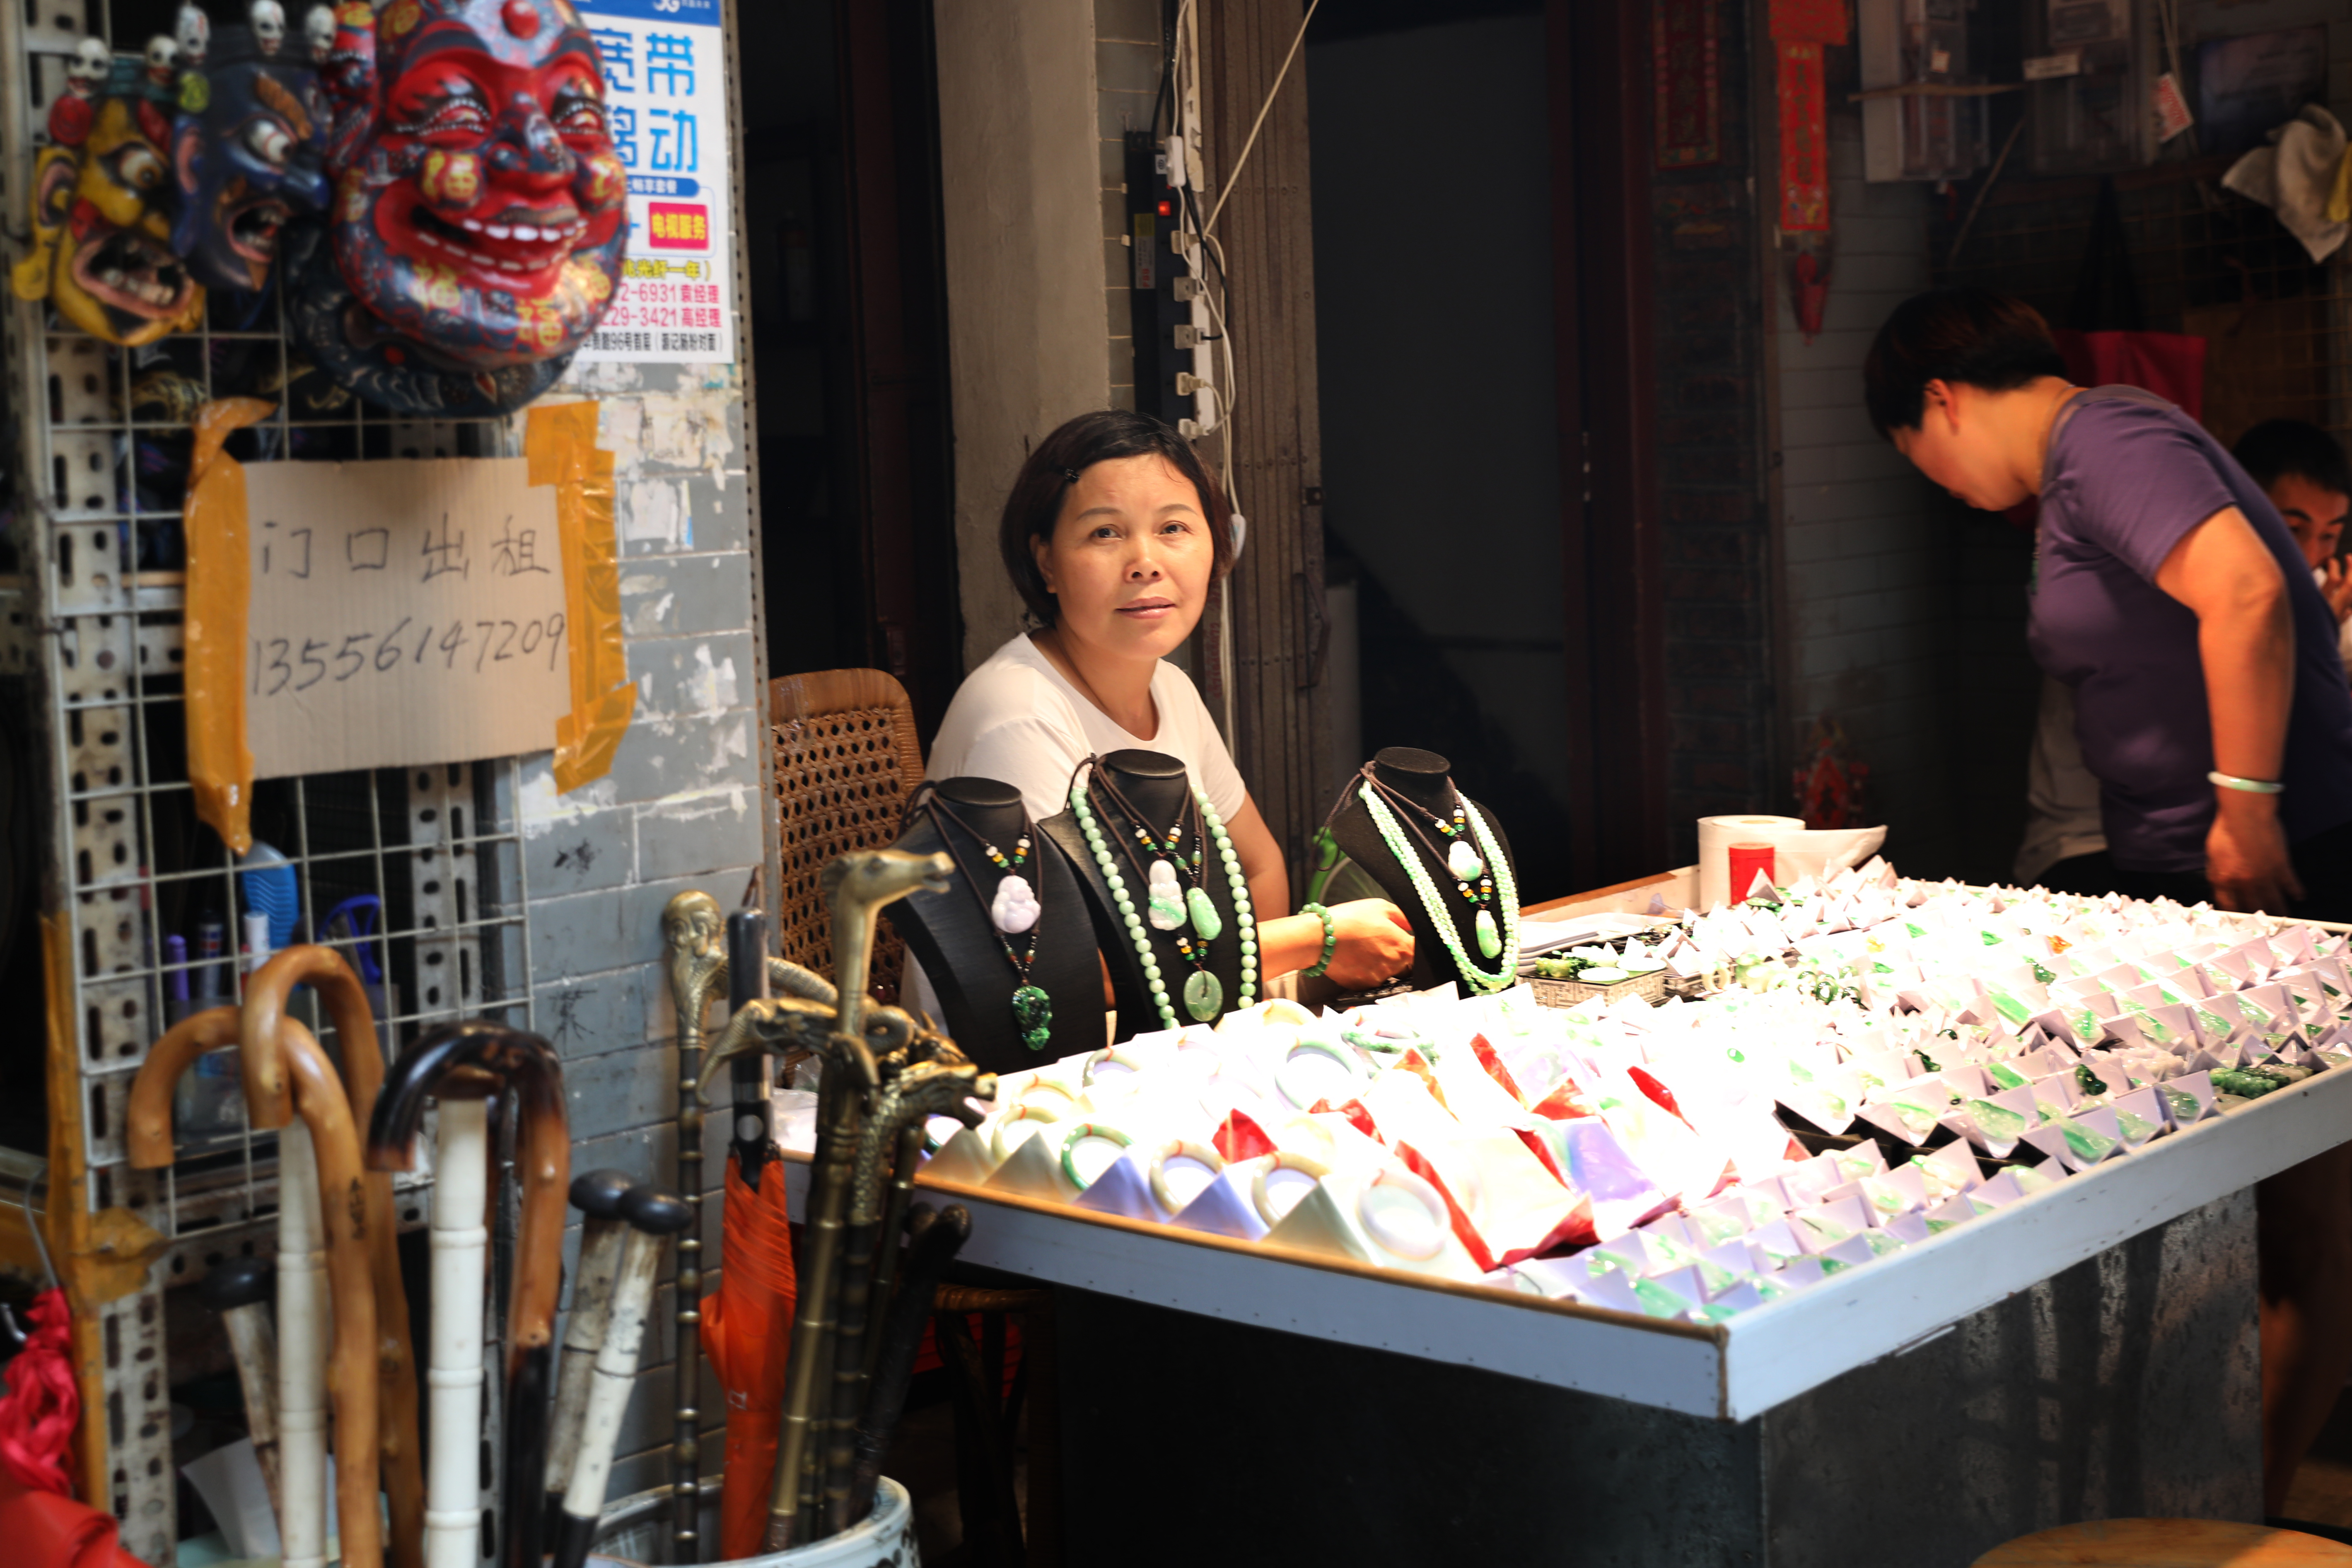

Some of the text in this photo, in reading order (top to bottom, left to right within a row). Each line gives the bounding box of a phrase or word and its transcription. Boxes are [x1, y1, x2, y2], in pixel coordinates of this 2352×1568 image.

[589, 27, 695, 96] 宽带
[263, 512, 550, 582] 门口出租
[254, 613, 565, 696] 13556147209
